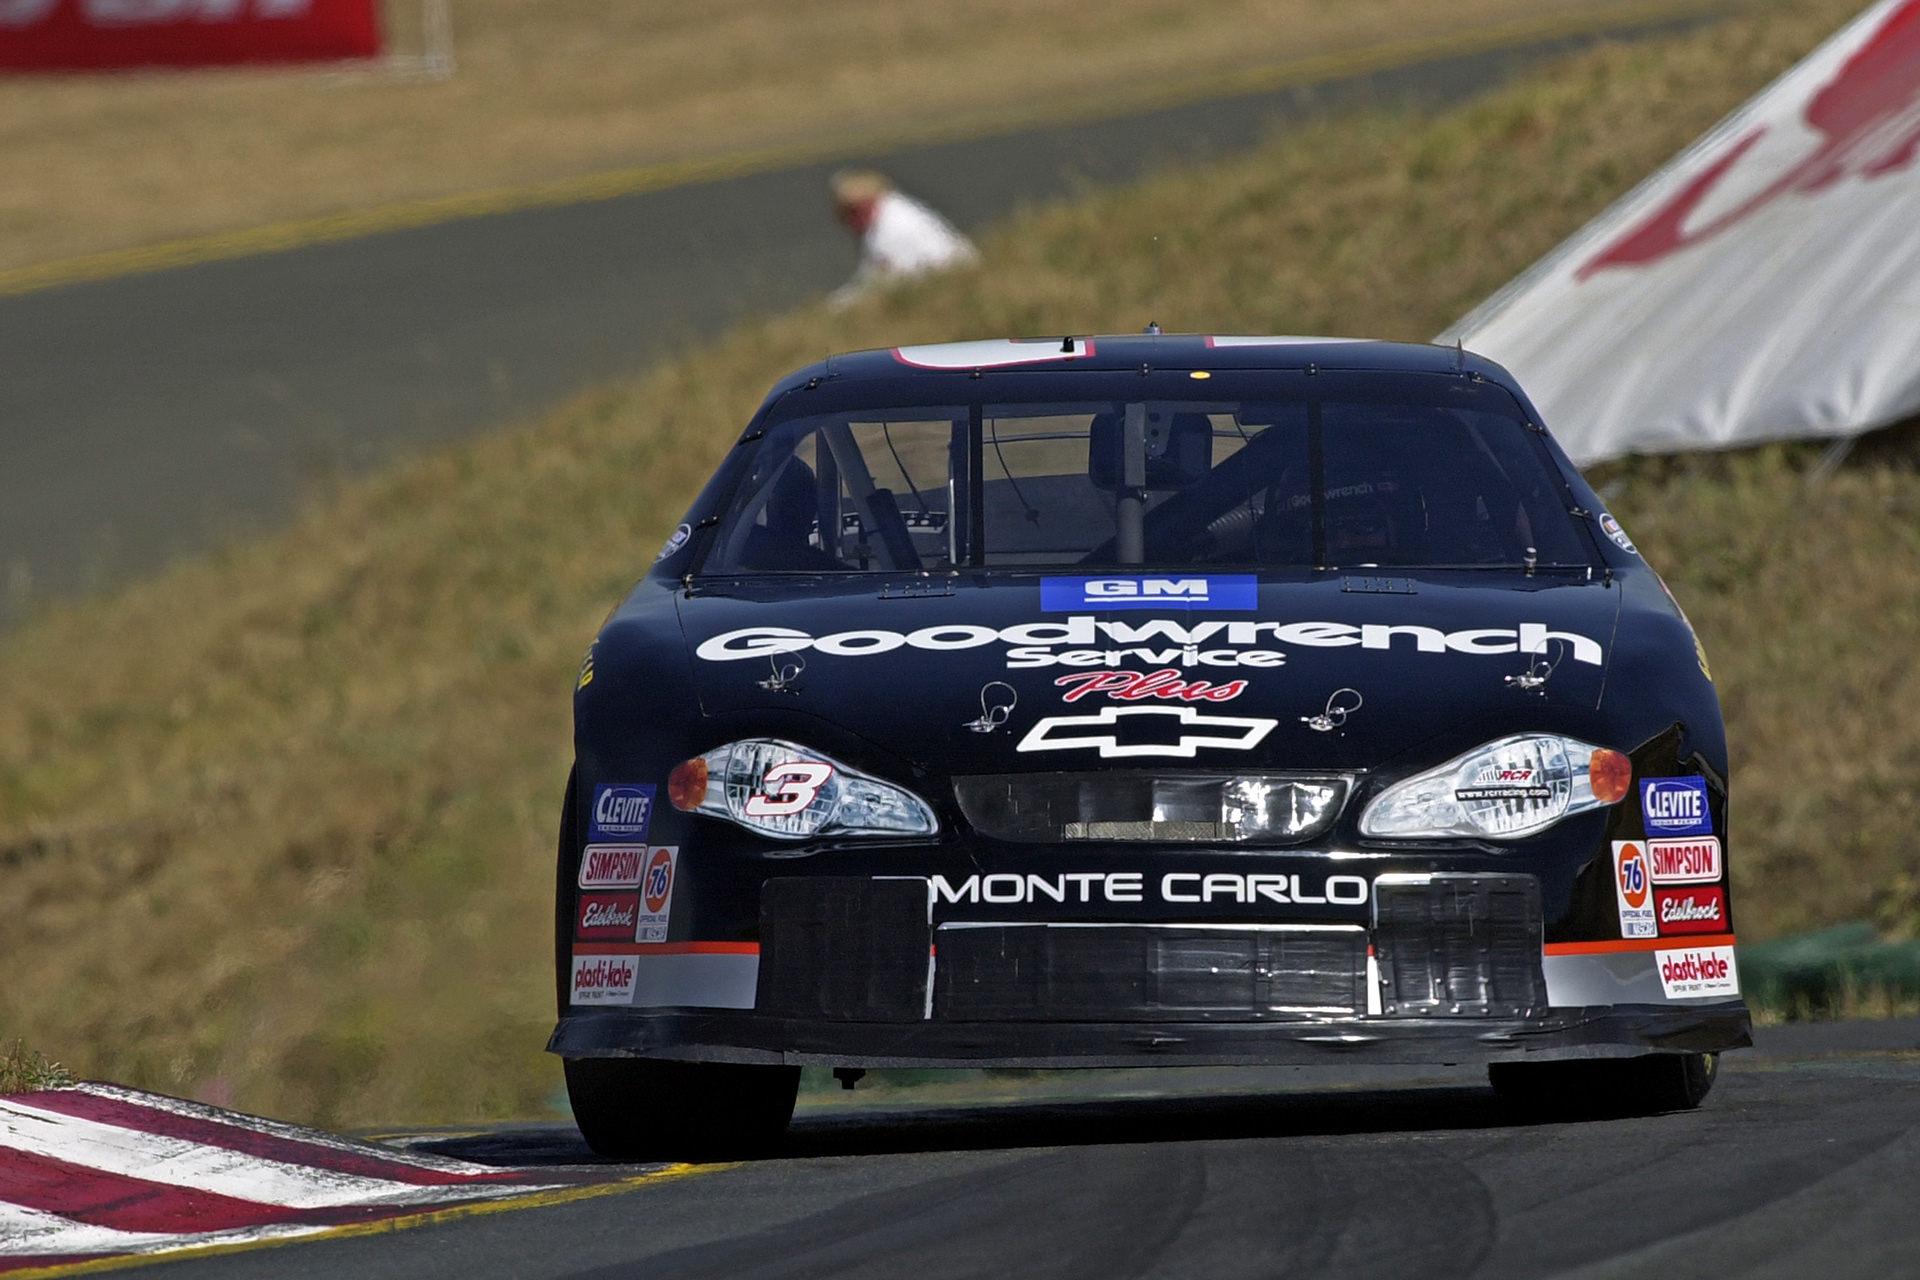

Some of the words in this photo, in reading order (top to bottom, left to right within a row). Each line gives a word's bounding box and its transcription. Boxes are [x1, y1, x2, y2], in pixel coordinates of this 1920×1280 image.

[1084, 579, 1209, 597] GM
[696, 616, 1602, 666] Goodwrench
[1006, 645, 1287, 669] Service
[1054, 668, 1248, 702] Plus
[744, 761, 834, 817] 3
[1499, 770, 1532, 781] RCR
[598, 788, 650, 823] CLEVITE
[1645, 782, 1702, 818] CLEVITE
[586, 852, 642, 881] SIMPSON
[1622, 857, 1645, 894] 76
[1653, 846, 1713, 875] SIMPSON
[647, 861, 670, 899] 76
[930, 872, 1143, 903] MONTE
[1161, 872, 1368, 905] CARLO
[582, 902, 634, 928] Edelbrock
[1661, 896, 1721, 923] Edelbrock
[1662, 952, 1729, 984] plasti-kote
